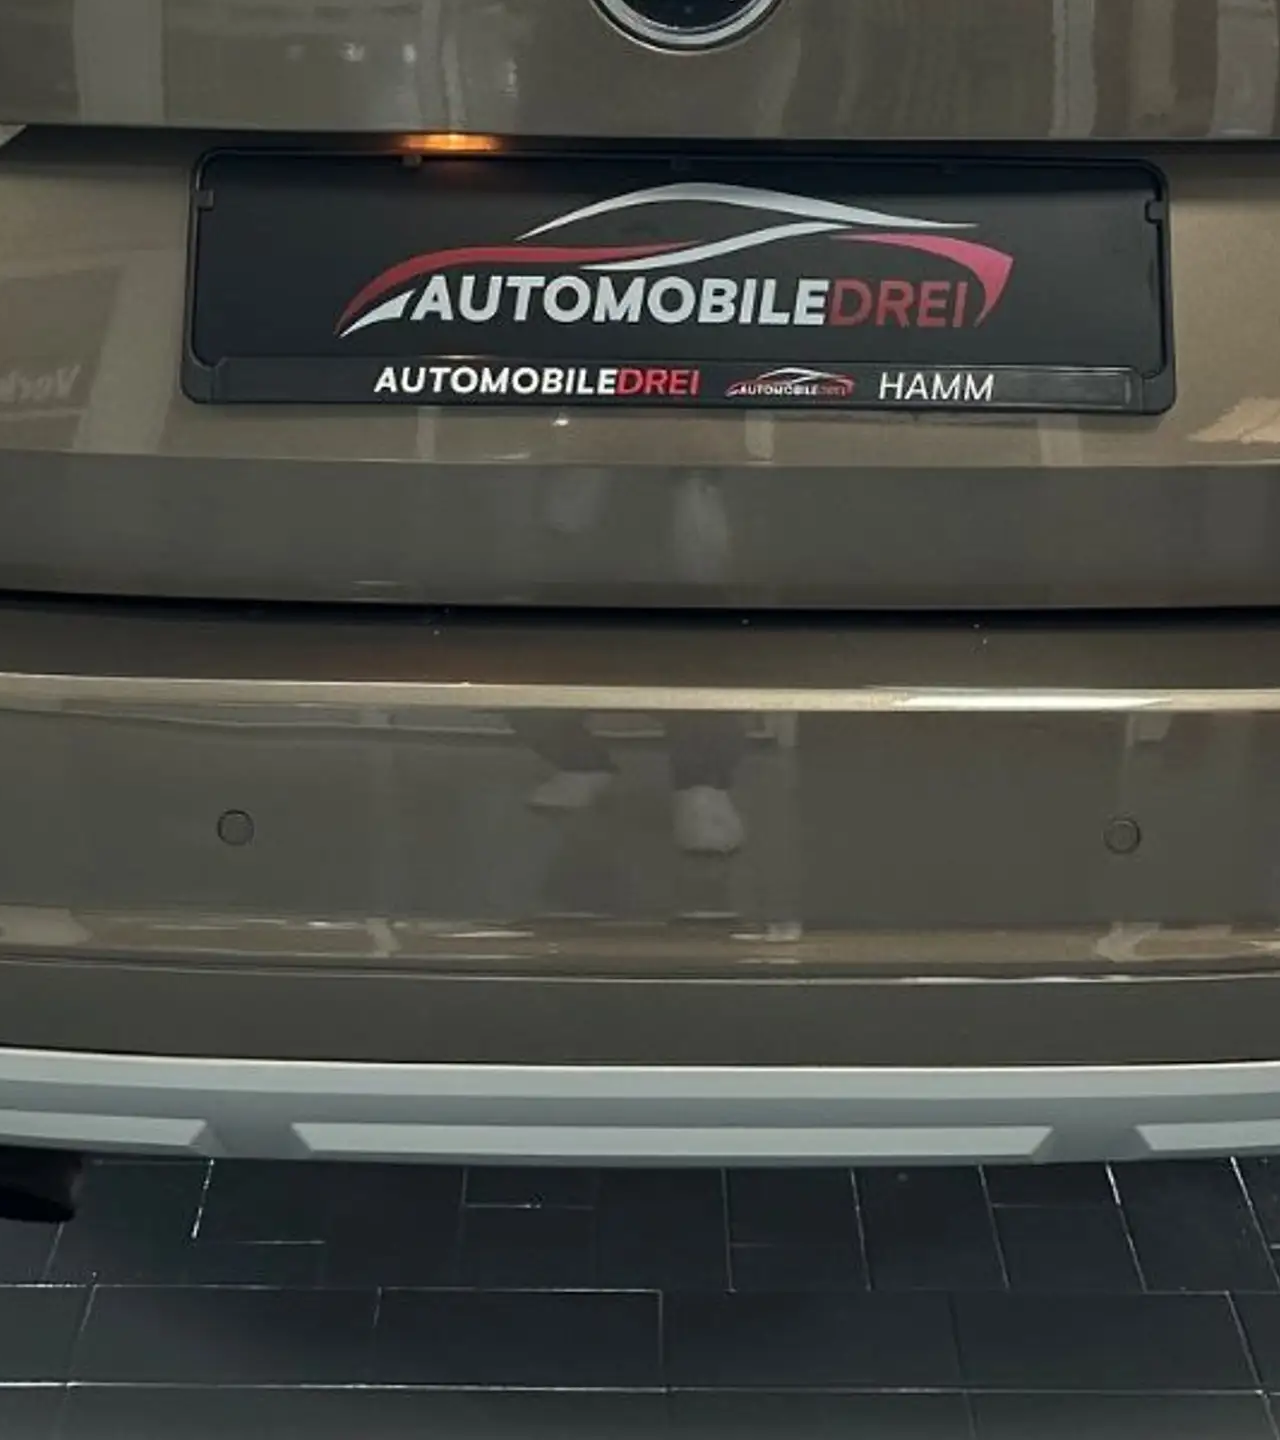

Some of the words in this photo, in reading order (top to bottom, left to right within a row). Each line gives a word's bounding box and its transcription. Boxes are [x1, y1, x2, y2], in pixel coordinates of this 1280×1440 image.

[409, 275, 969, 328] AUTOMOBILEDREI
[373, 366, 701, 397] AUTOMOBILEDREI
[878, 370, 995, 402] HAMM
